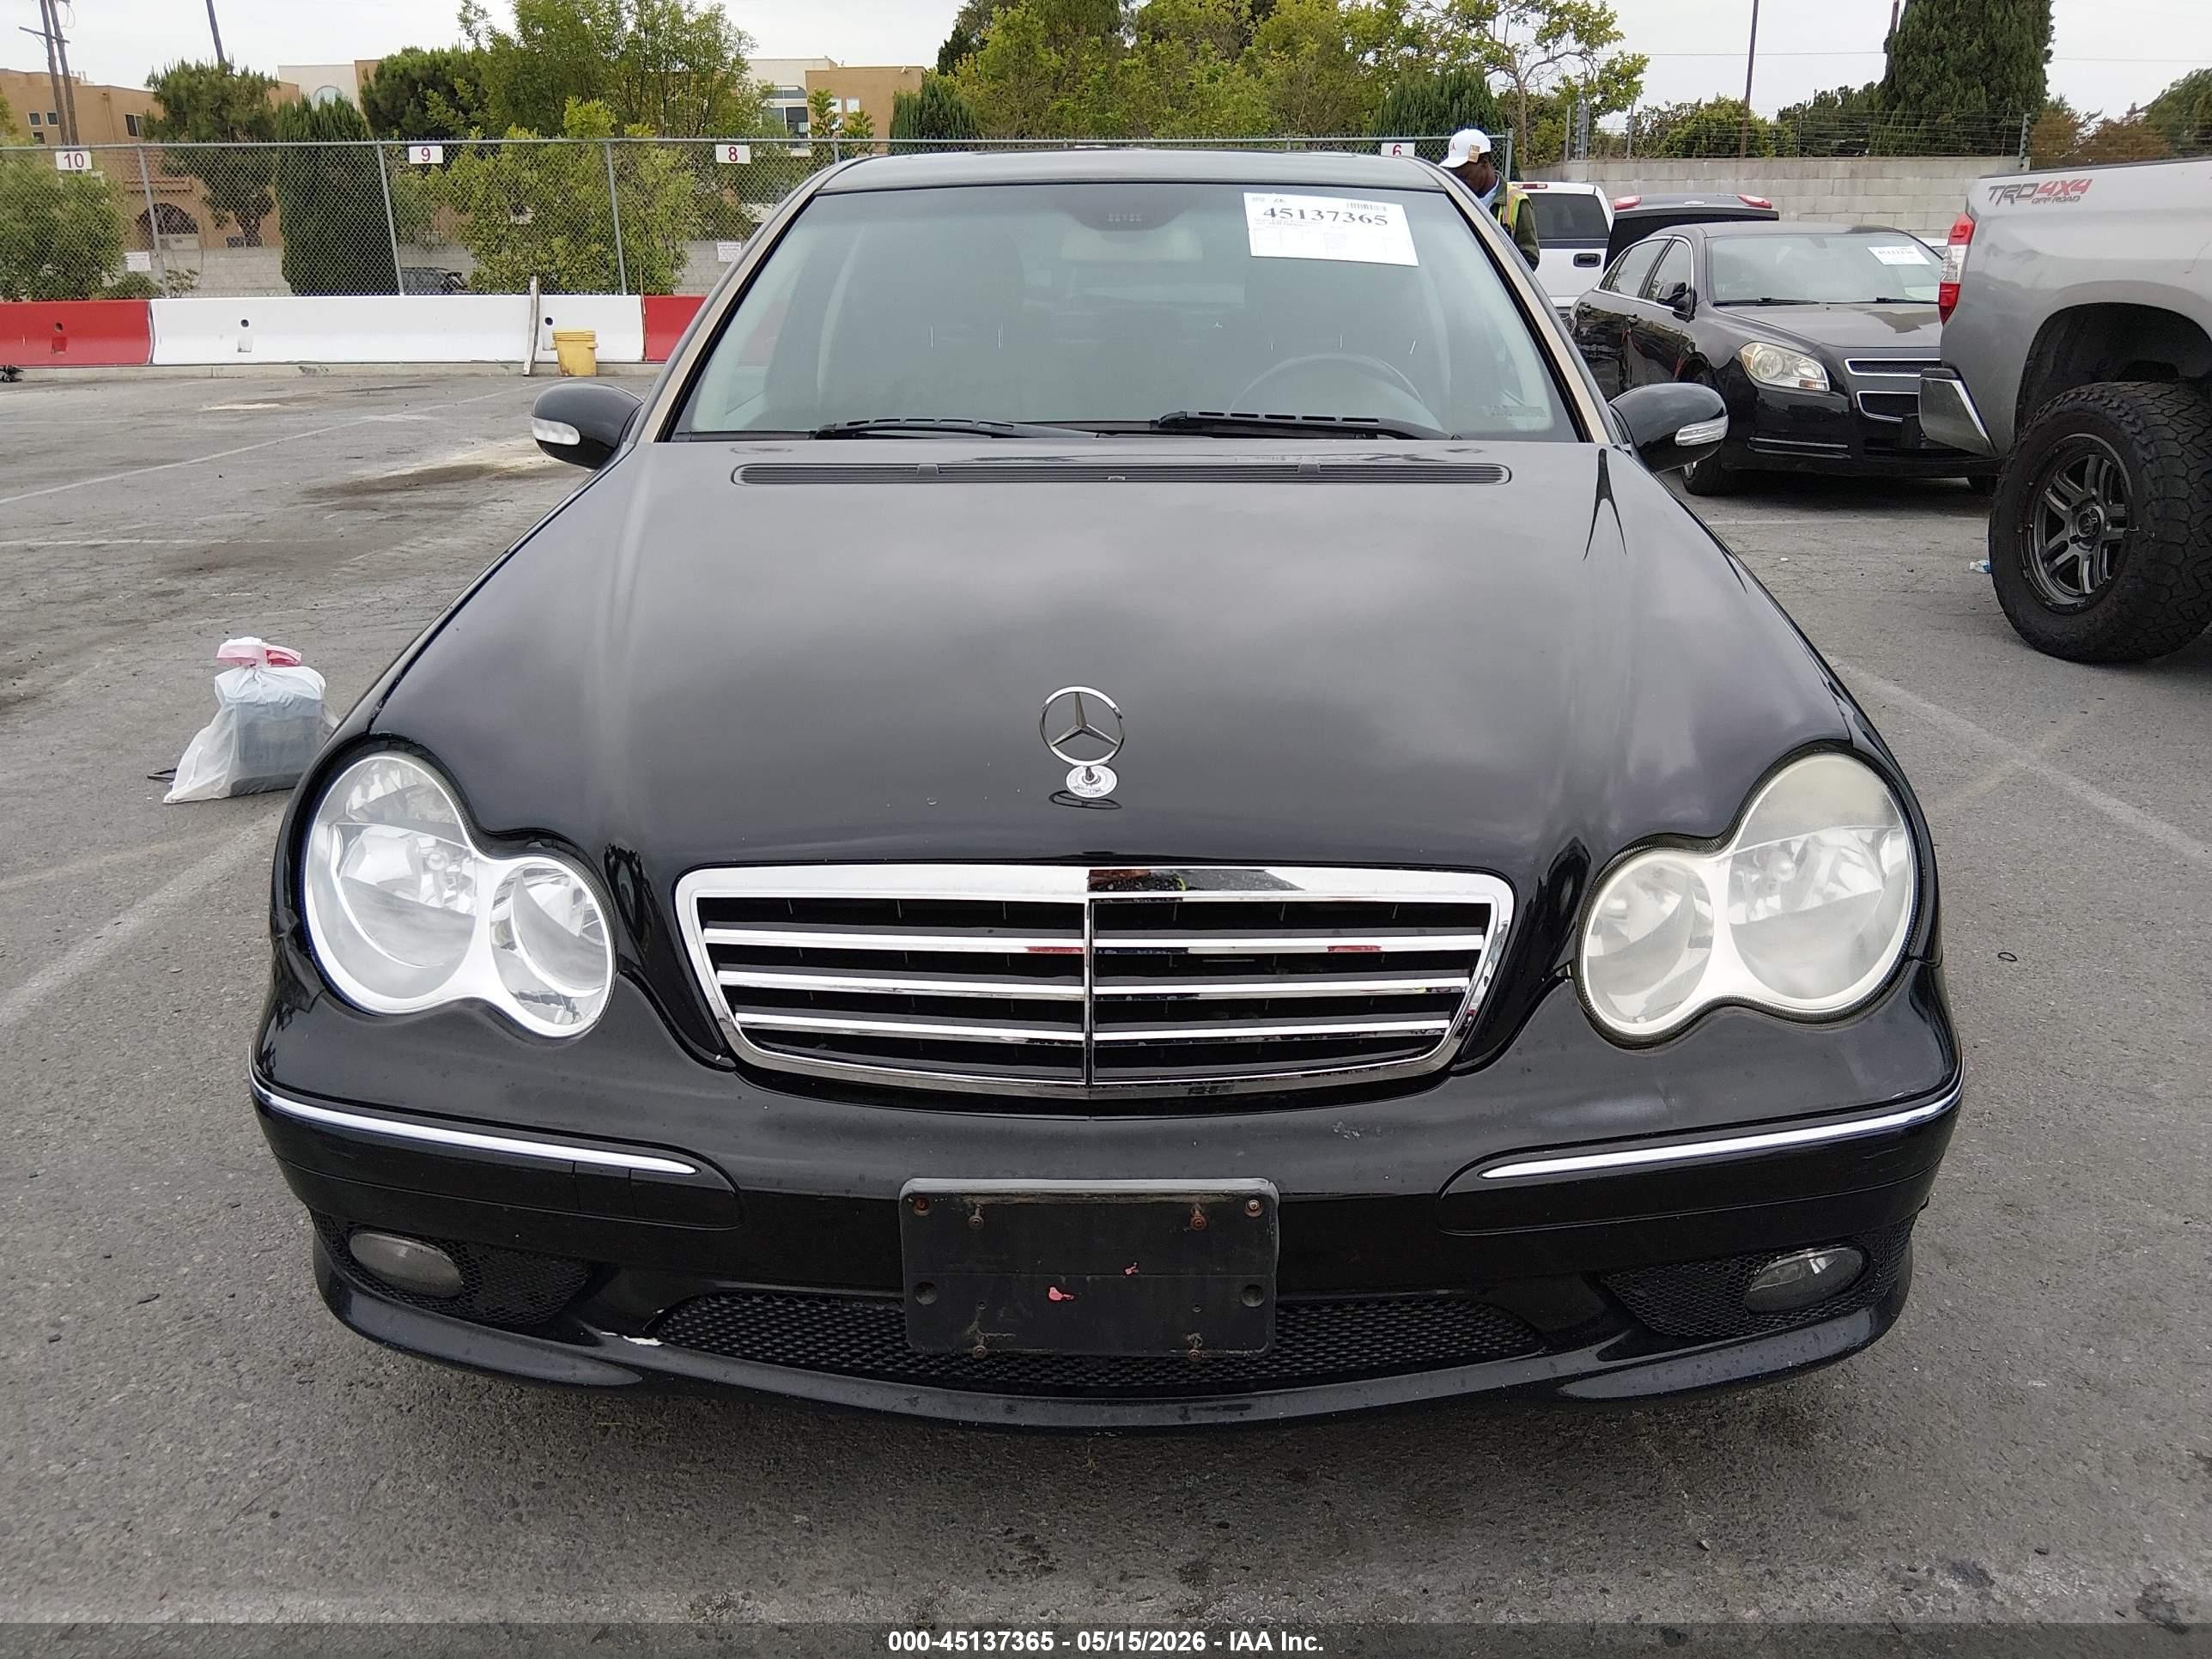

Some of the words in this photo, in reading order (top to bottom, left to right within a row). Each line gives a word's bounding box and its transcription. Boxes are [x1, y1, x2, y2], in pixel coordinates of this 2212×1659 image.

[421, 147, 431, 162] 9
[728, 146, 738, 162] 8
[1392, 144, 1402, 156] 6
[64, 153, 84, 168] 10
[1989, 182, 2039, 205] TRD
[2051, 195, 2081, 204] ROAD
[1263, 207, 1389, 227] 45137365
